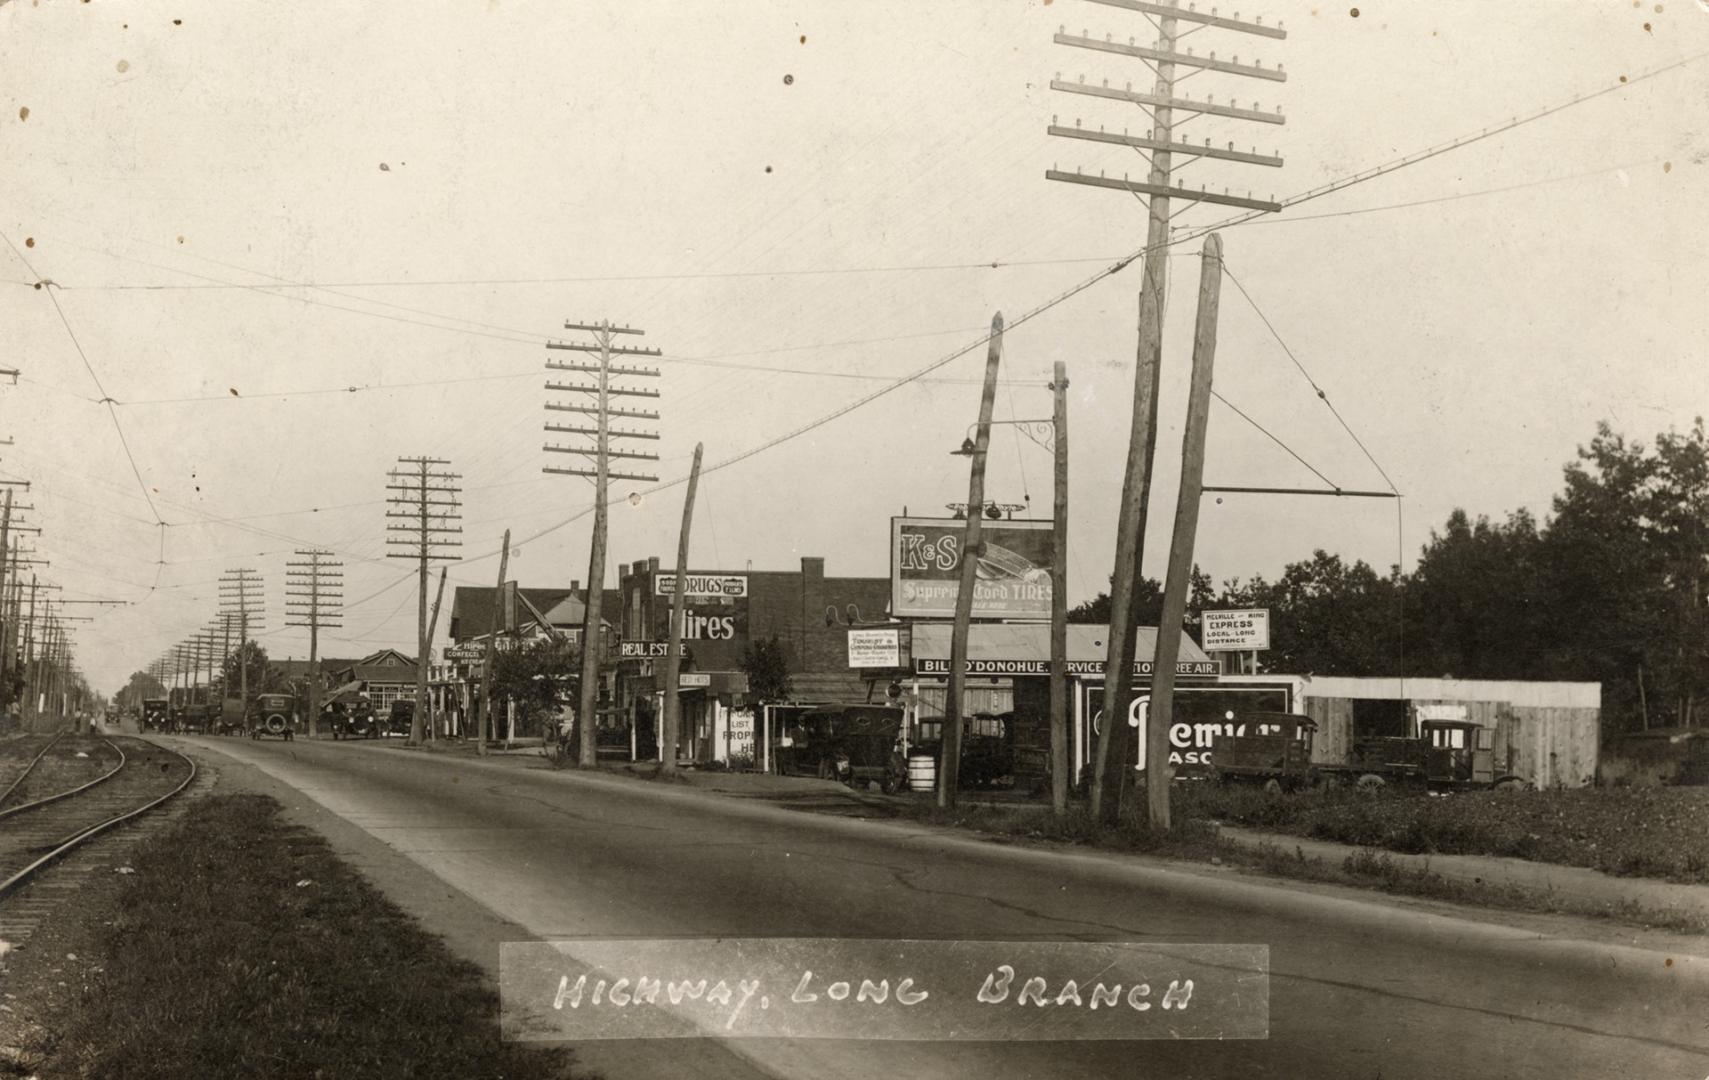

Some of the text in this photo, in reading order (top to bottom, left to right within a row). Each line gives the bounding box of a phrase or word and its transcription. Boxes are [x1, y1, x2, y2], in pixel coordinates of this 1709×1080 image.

[901, 534, 958, 571] K&S
[903, 582, 960, 602] Suprem
[1209, 620, 1253, 630] EXPRESS
[622, 643, 687, 656] REAL ESTE
[924, 660, 951, 672] BIL
[1065, 662, 1103, 673] RVICE
[1176, 663, 1193, 674] REE
[1193, 663, 1217, 674] AIR.
[731, 720, 749, 729] LIST
